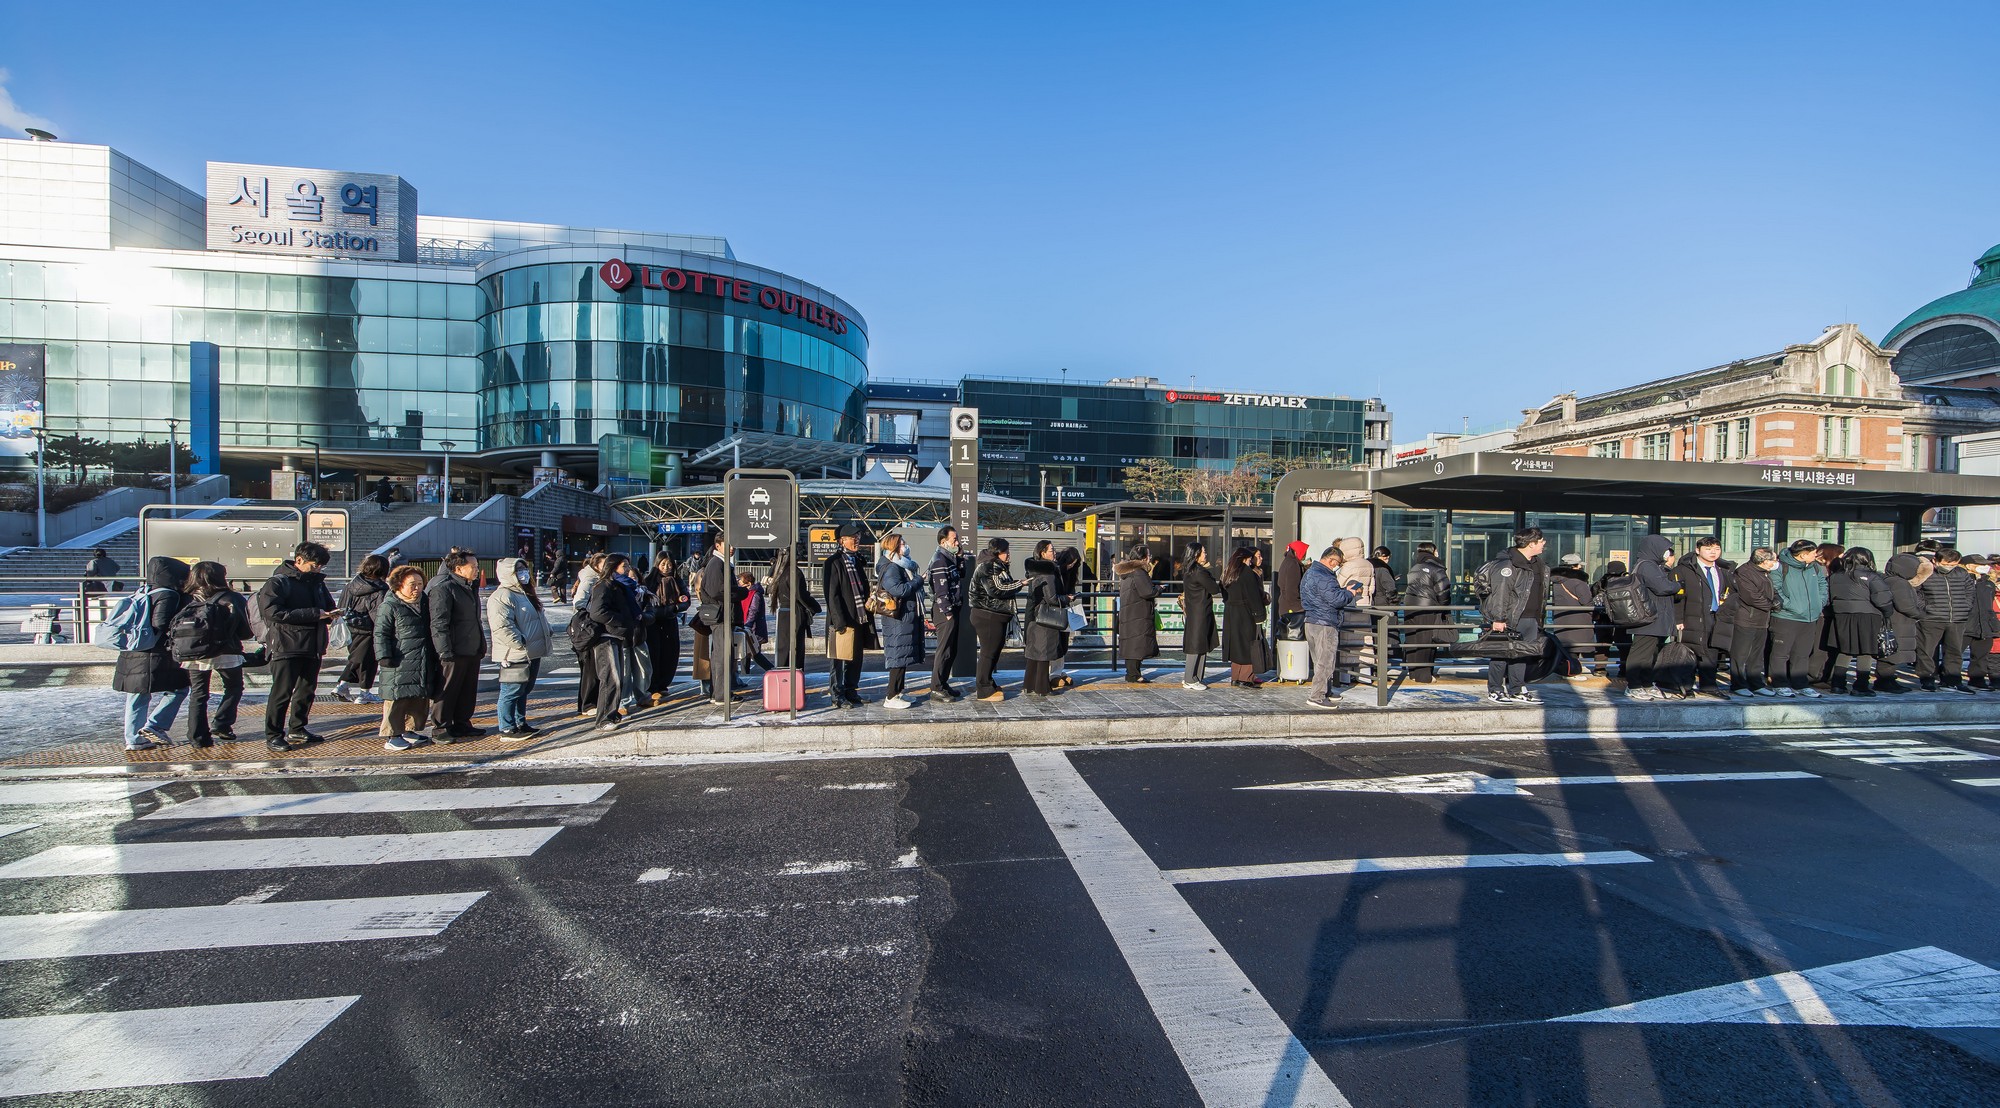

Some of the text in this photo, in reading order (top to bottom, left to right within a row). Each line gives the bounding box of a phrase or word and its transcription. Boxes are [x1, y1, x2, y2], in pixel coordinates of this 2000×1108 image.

[228, 176, 378, 225] 서울역
[230, 225, 378, 251] Seoul Station
[641, 266, 847, 335] LOTTE OUTLETS
[1223, 394, 1307, 409] ZETTAPLEX
[961, 445, 970, 460] 1
[1522, 460, 1554, 469] 서울특별시
[1761, 469, 1855, 485] 서울역 택시환승센터
[748, 509, 772, 521] 택시
[960, 482, 970, 546] 택시 타는 곳
